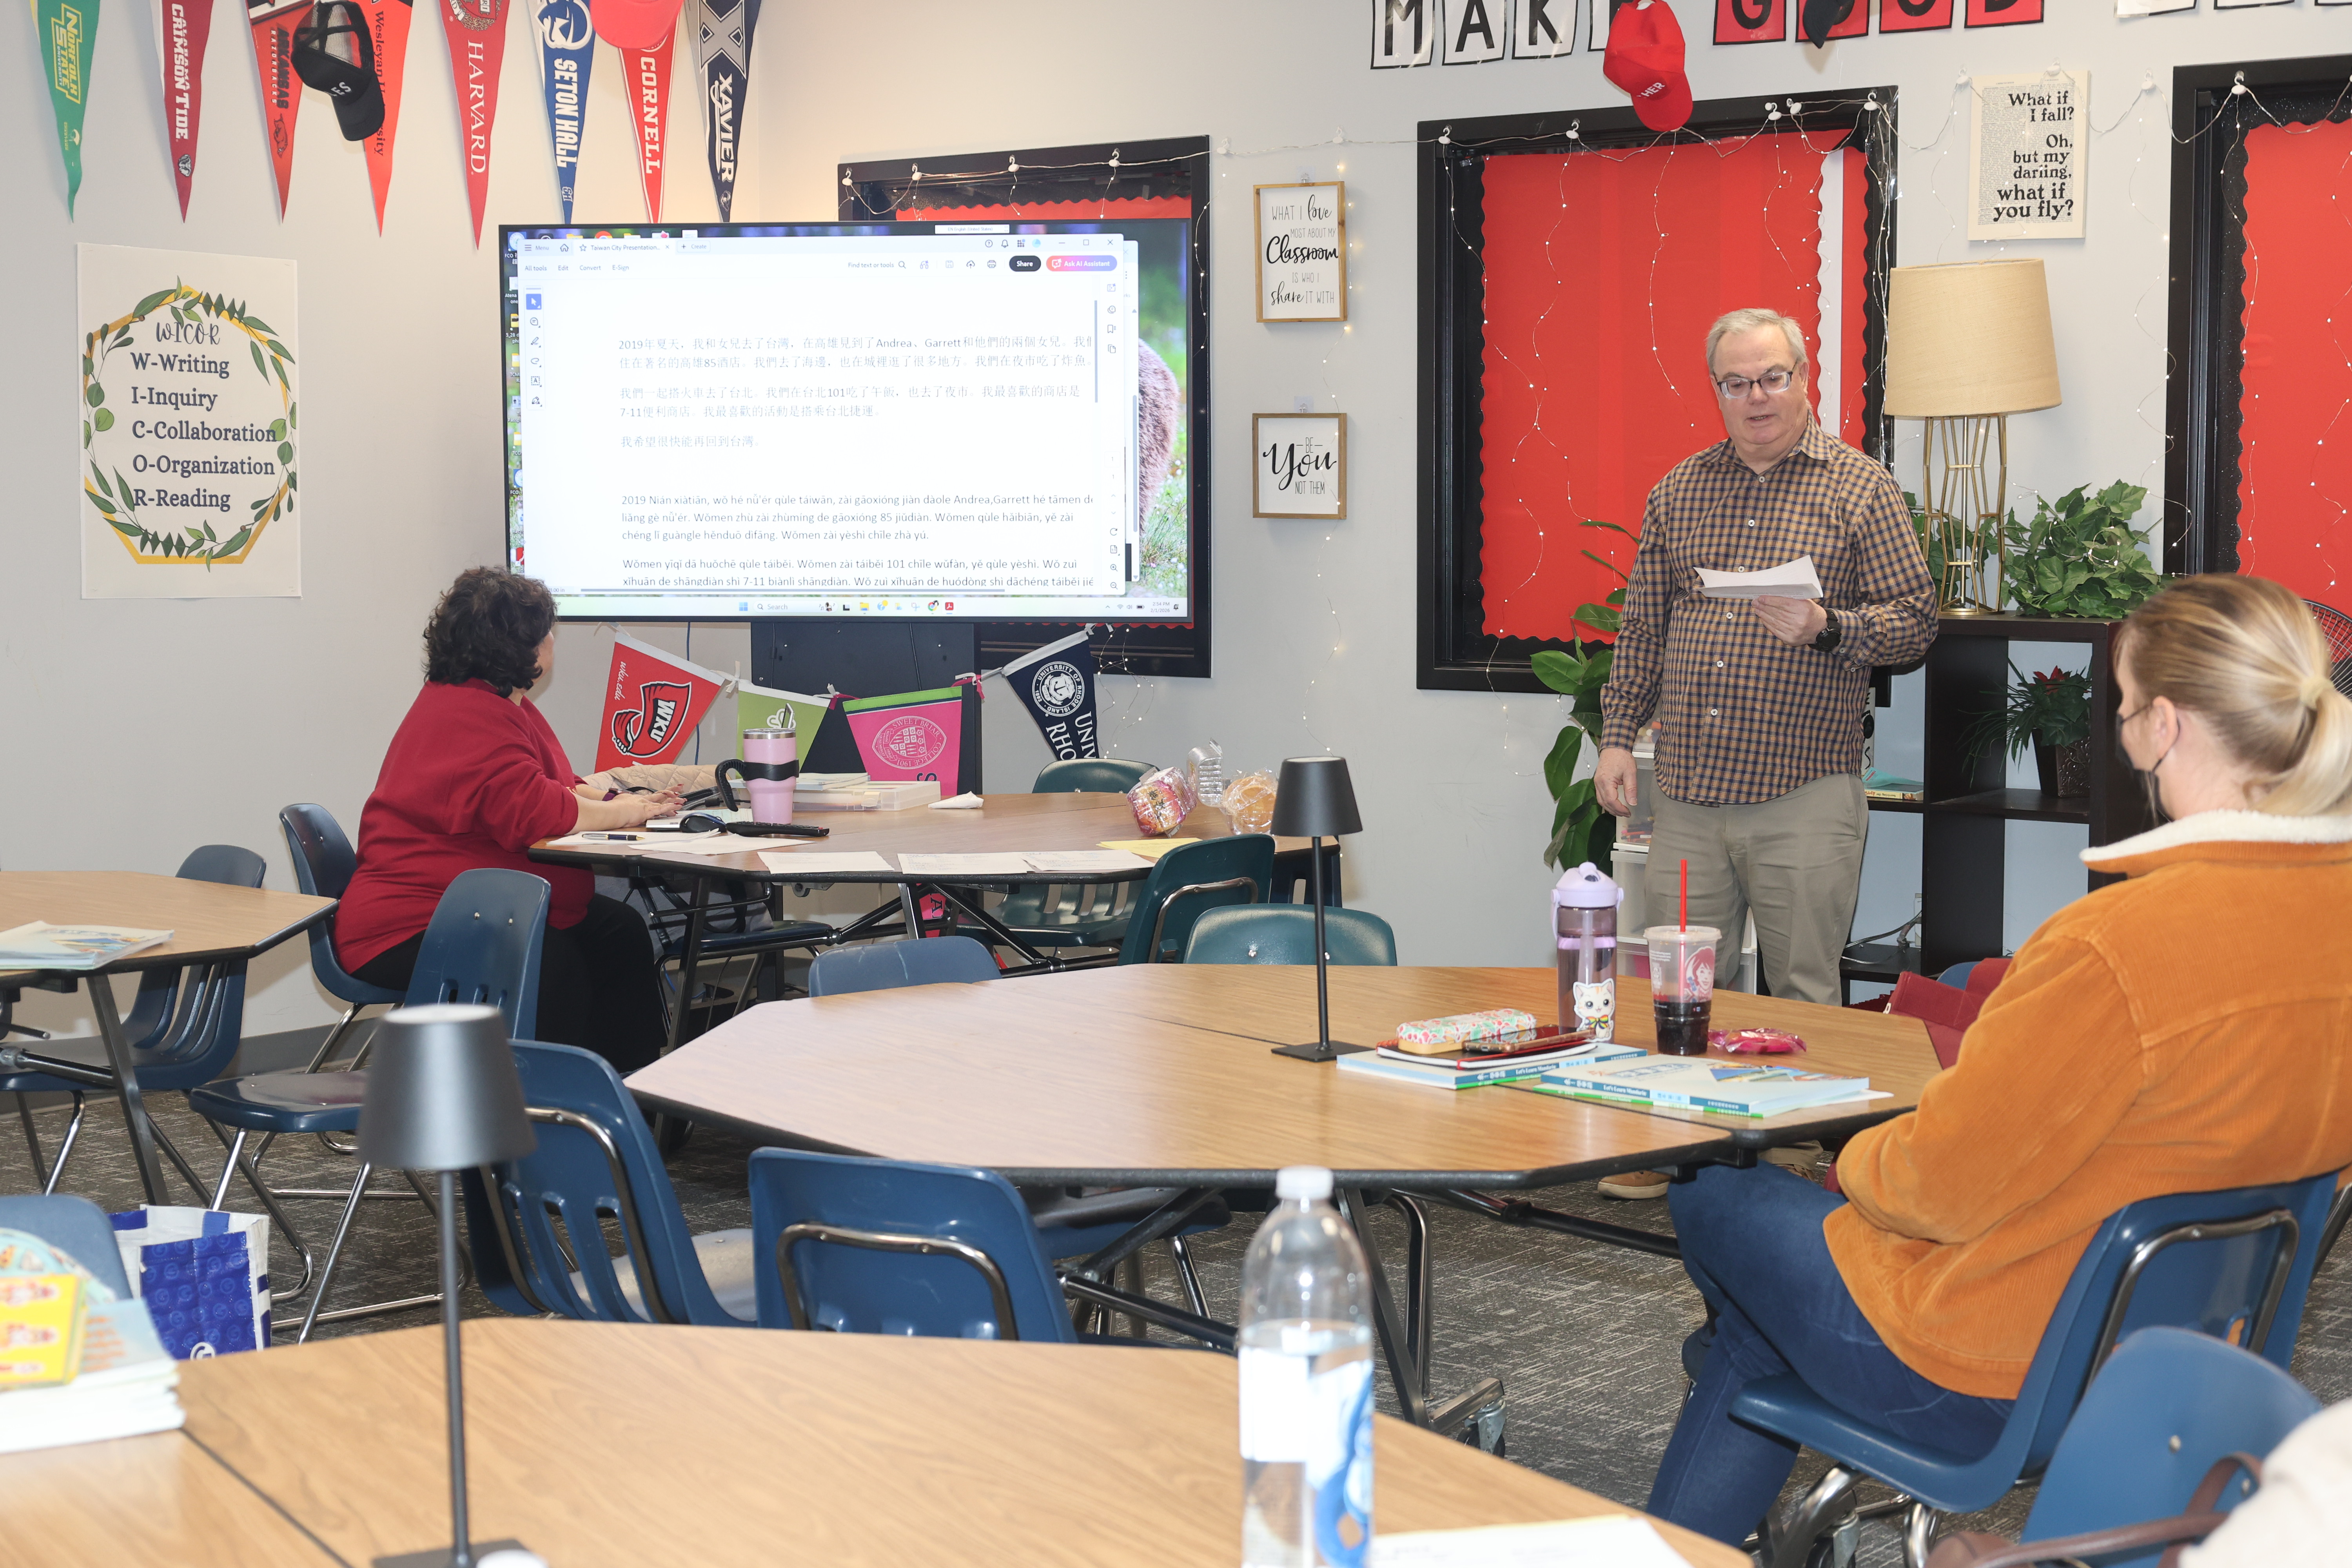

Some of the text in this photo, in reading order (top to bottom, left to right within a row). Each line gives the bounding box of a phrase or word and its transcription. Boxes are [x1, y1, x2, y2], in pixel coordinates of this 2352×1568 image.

[1384, 0, 1614, 56] MAK
[55, 25, 70, 89] STATE
[66, 11, 78, 96] NORFOLK
[182, 18, 191, 91] ALABAMA
[374, 11, 385, 78] Wesleyan
[171, 3, 190, 140] CRIMSON TIDE
[276, 24, 290, 110] ARKANSAS
[468, 39, 486, 173] HARVARD
[2008, 90, 2069, 106] What if
[554, 58, 579, 168] SETON HALL
[640, 56, 661, 174] CORNELL
[2030, 106, 2074, 122] I fall?
[719, 71, 735, 183] XAVIER
[2046, 133, 2073, 149] Oh,
[2013, 150, 2070, 165] but my
[1996, 182, 2066, 201] what if
[1272, 194, 1332, 221] WHAT I love
[1993, 198, 2074, 222] you fly?
[1290, 227, 1337, 238] MOST ABOUT MY
[1266, 234, 1339, 264] Classroom
[1292, 272, 1319, 283] IS WHO I
[1271, 281, 1334, 306] share IT WITH
[155, 321, 220, 345] WICOR
[130, 352, 230, 379] W-Writing
[131, 386, 218, 412] I-Inquiry
[131, 420, 277, 443] C-Collaboration
[1305, 437, 1314, 453] BE
[132, 454, 275, 478] O-Organization
[1263, 443, 1337, 491] You
[133, 488, 231, 512] R-Reading
[622, 495, 646, 505] 2019
[1295, 481, 1325, 494] NOT THEM
[817, 512, 829, 522] de
[880, 512, 892, 522] 85
[887, 559, 905, 568] 101
[614, 661, 629, 701] wku.edu
[1037, 664, 1082, 714] UNIVERSITY OF RHODE ISLAND
[650, 699, 676, 744] WKU
[892, 718, 919, 729] SWEET
[920, 720, 940, 738] BRIAR
[913, 742, 942, 767] COLLEGE
